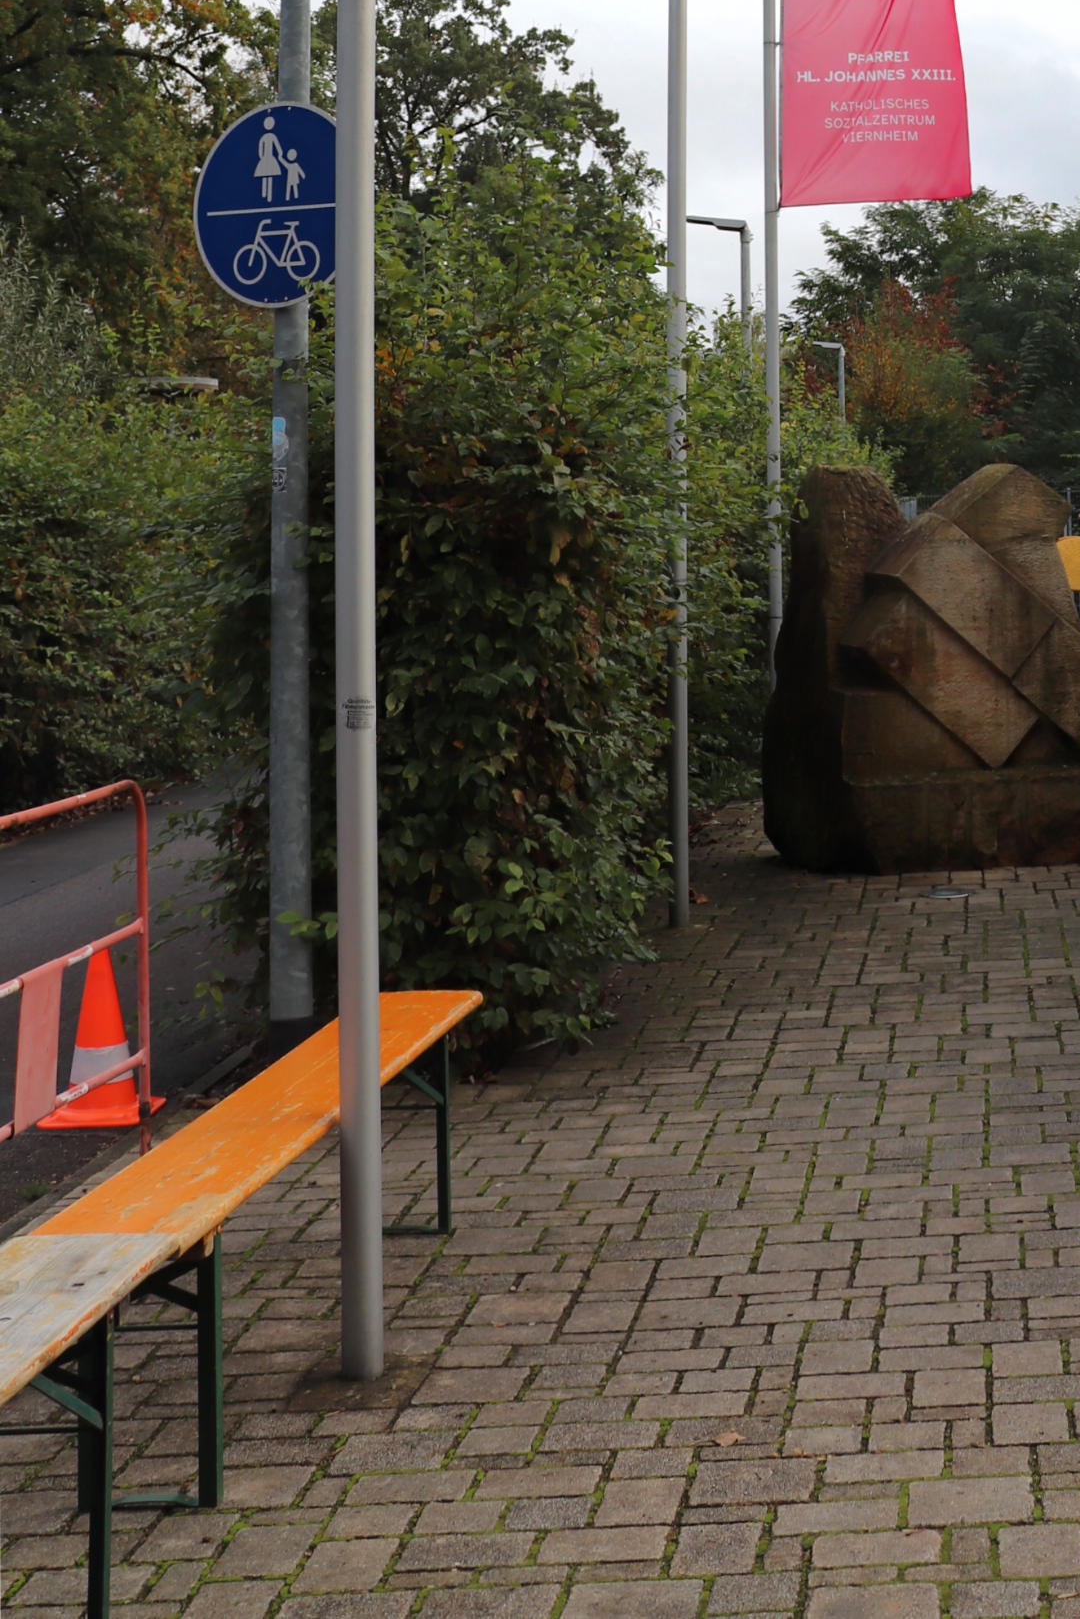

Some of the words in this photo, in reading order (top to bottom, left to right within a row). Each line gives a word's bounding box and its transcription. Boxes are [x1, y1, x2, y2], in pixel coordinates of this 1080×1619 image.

[848, 51, 909, 65] PFARREI
[796, 71, 820, 83] HL.
[824, 69, 906, 83] JOHANNES
[911, 69, 956, 81] XXIII.
[830, 98, 929, 112] KATHOLISCHES
[824, 115, 936, 129] SOZIALZENTRUM
[842, 131, 918, 143] VIERNHEIM
